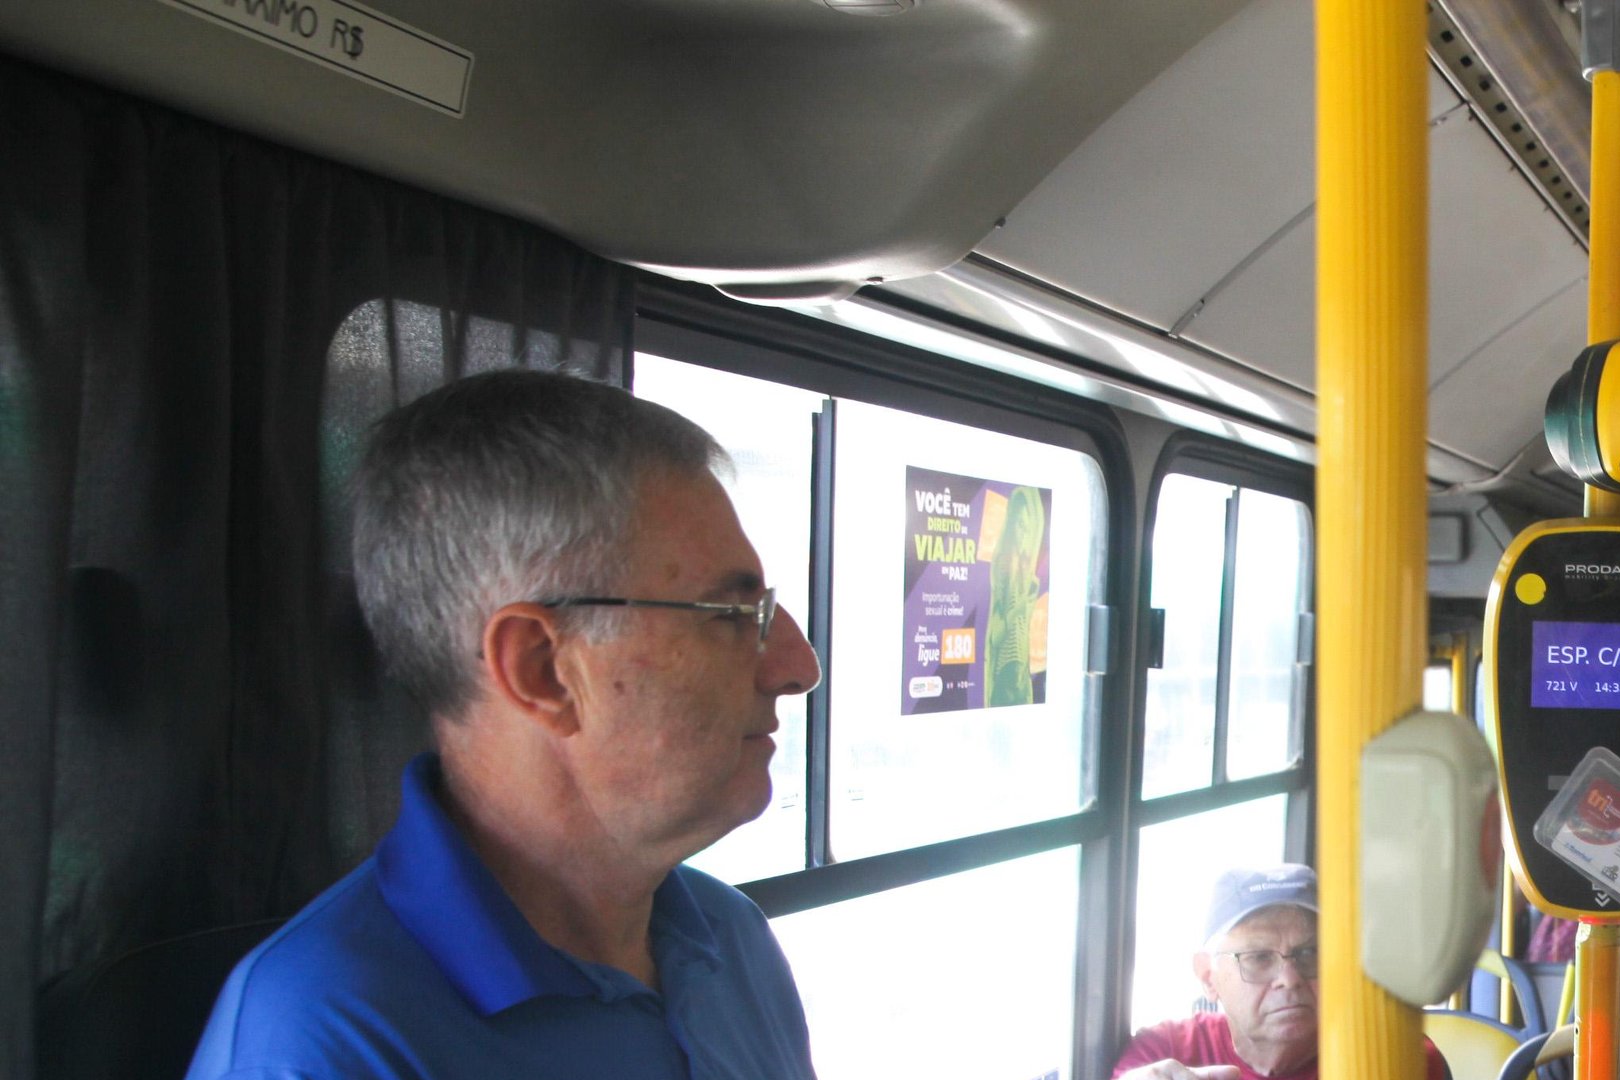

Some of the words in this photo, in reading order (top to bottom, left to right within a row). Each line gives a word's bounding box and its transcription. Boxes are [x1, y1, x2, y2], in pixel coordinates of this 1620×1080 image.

[330, 18, 364, 60] R$
[915, 487, 951, 516] VOCÊ
[952, 502, 970, 518] TEM
[928, 516, 961, 533] DIREITO
[914, 534, 976, 564] VIAJAR
[949, 566, 969, 581] PAZ!
[918, 644, 940, 667] ligue
[944, 634, 972, 659] 180
[1547, 645, 1590, 664] ESP.
[1546, 680, 1566, 691] 721
[1569, 681, 1578, 692] V
